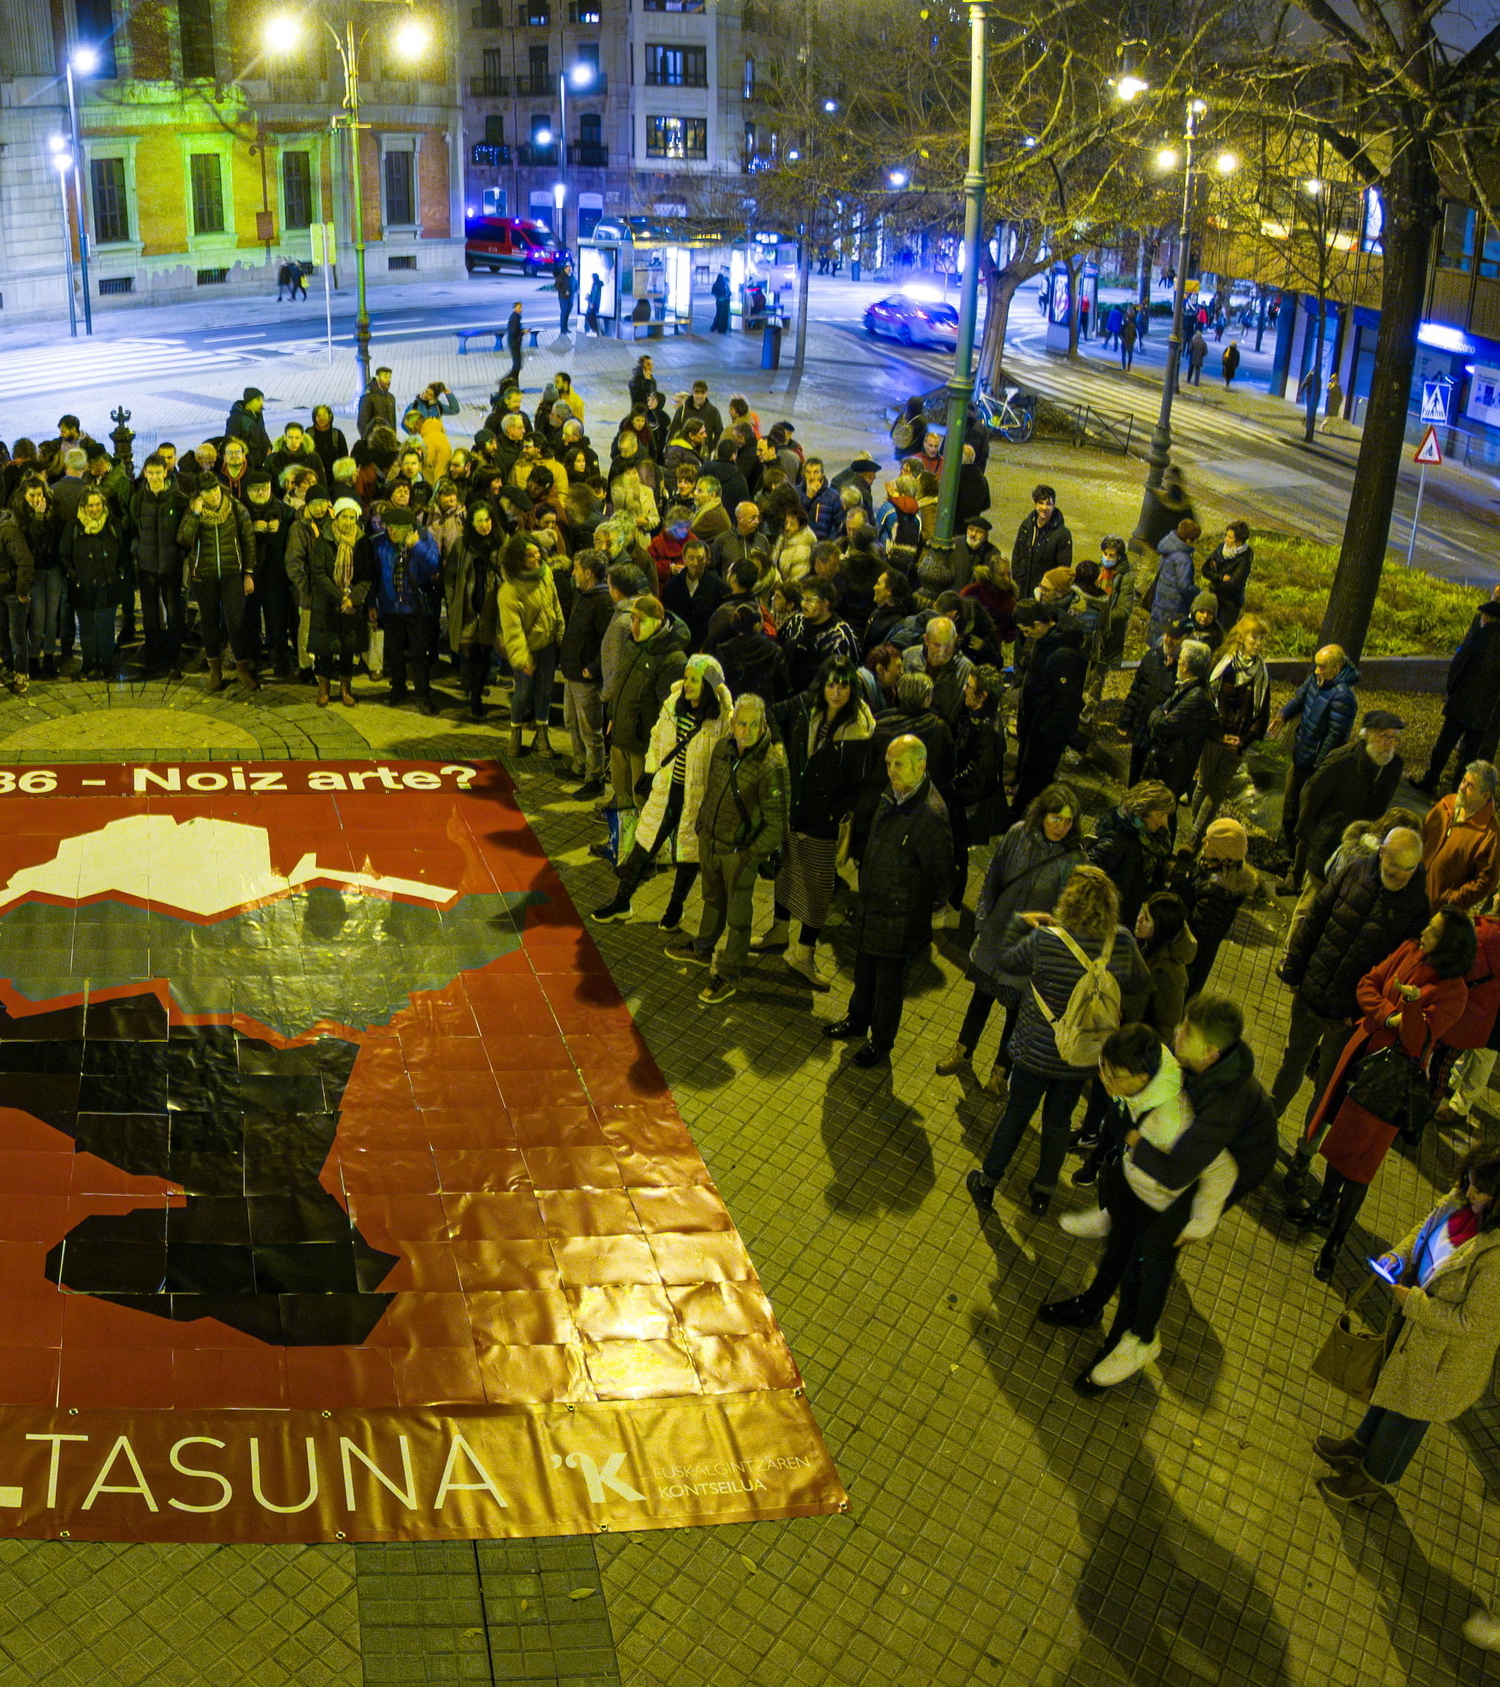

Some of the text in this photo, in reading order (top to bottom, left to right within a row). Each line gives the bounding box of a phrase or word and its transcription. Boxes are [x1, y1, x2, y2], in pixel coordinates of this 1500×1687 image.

[133, 766, 288, 793] Noiz
[307, 765, 477, 792] arte?
[658, 1478, 767, 1499] KONTSEILUA
